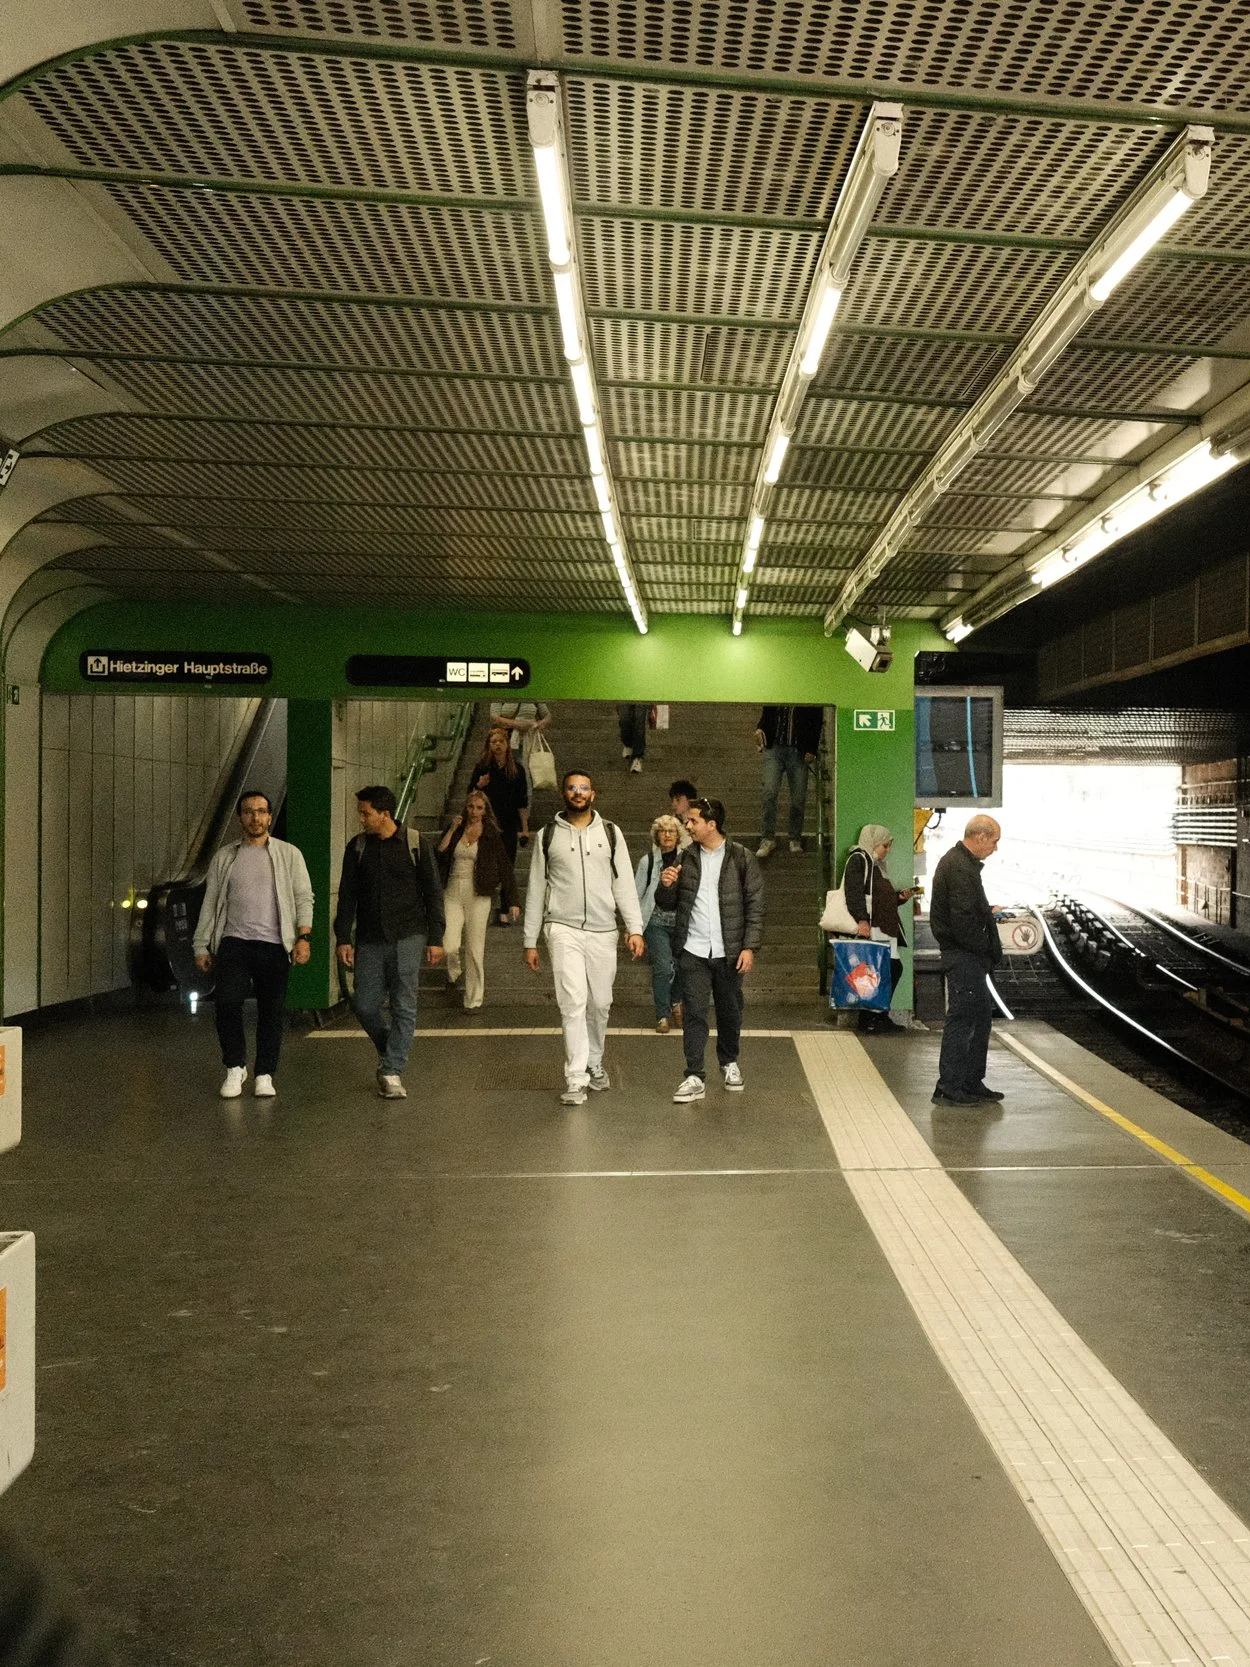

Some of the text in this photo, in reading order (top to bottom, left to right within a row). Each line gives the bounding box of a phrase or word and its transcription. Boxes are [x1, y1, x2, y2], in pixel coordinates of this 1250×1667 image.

[109, 660, 268, 676] Hietzinger Hauptstraße
[448, 668, 466, 677] WC
